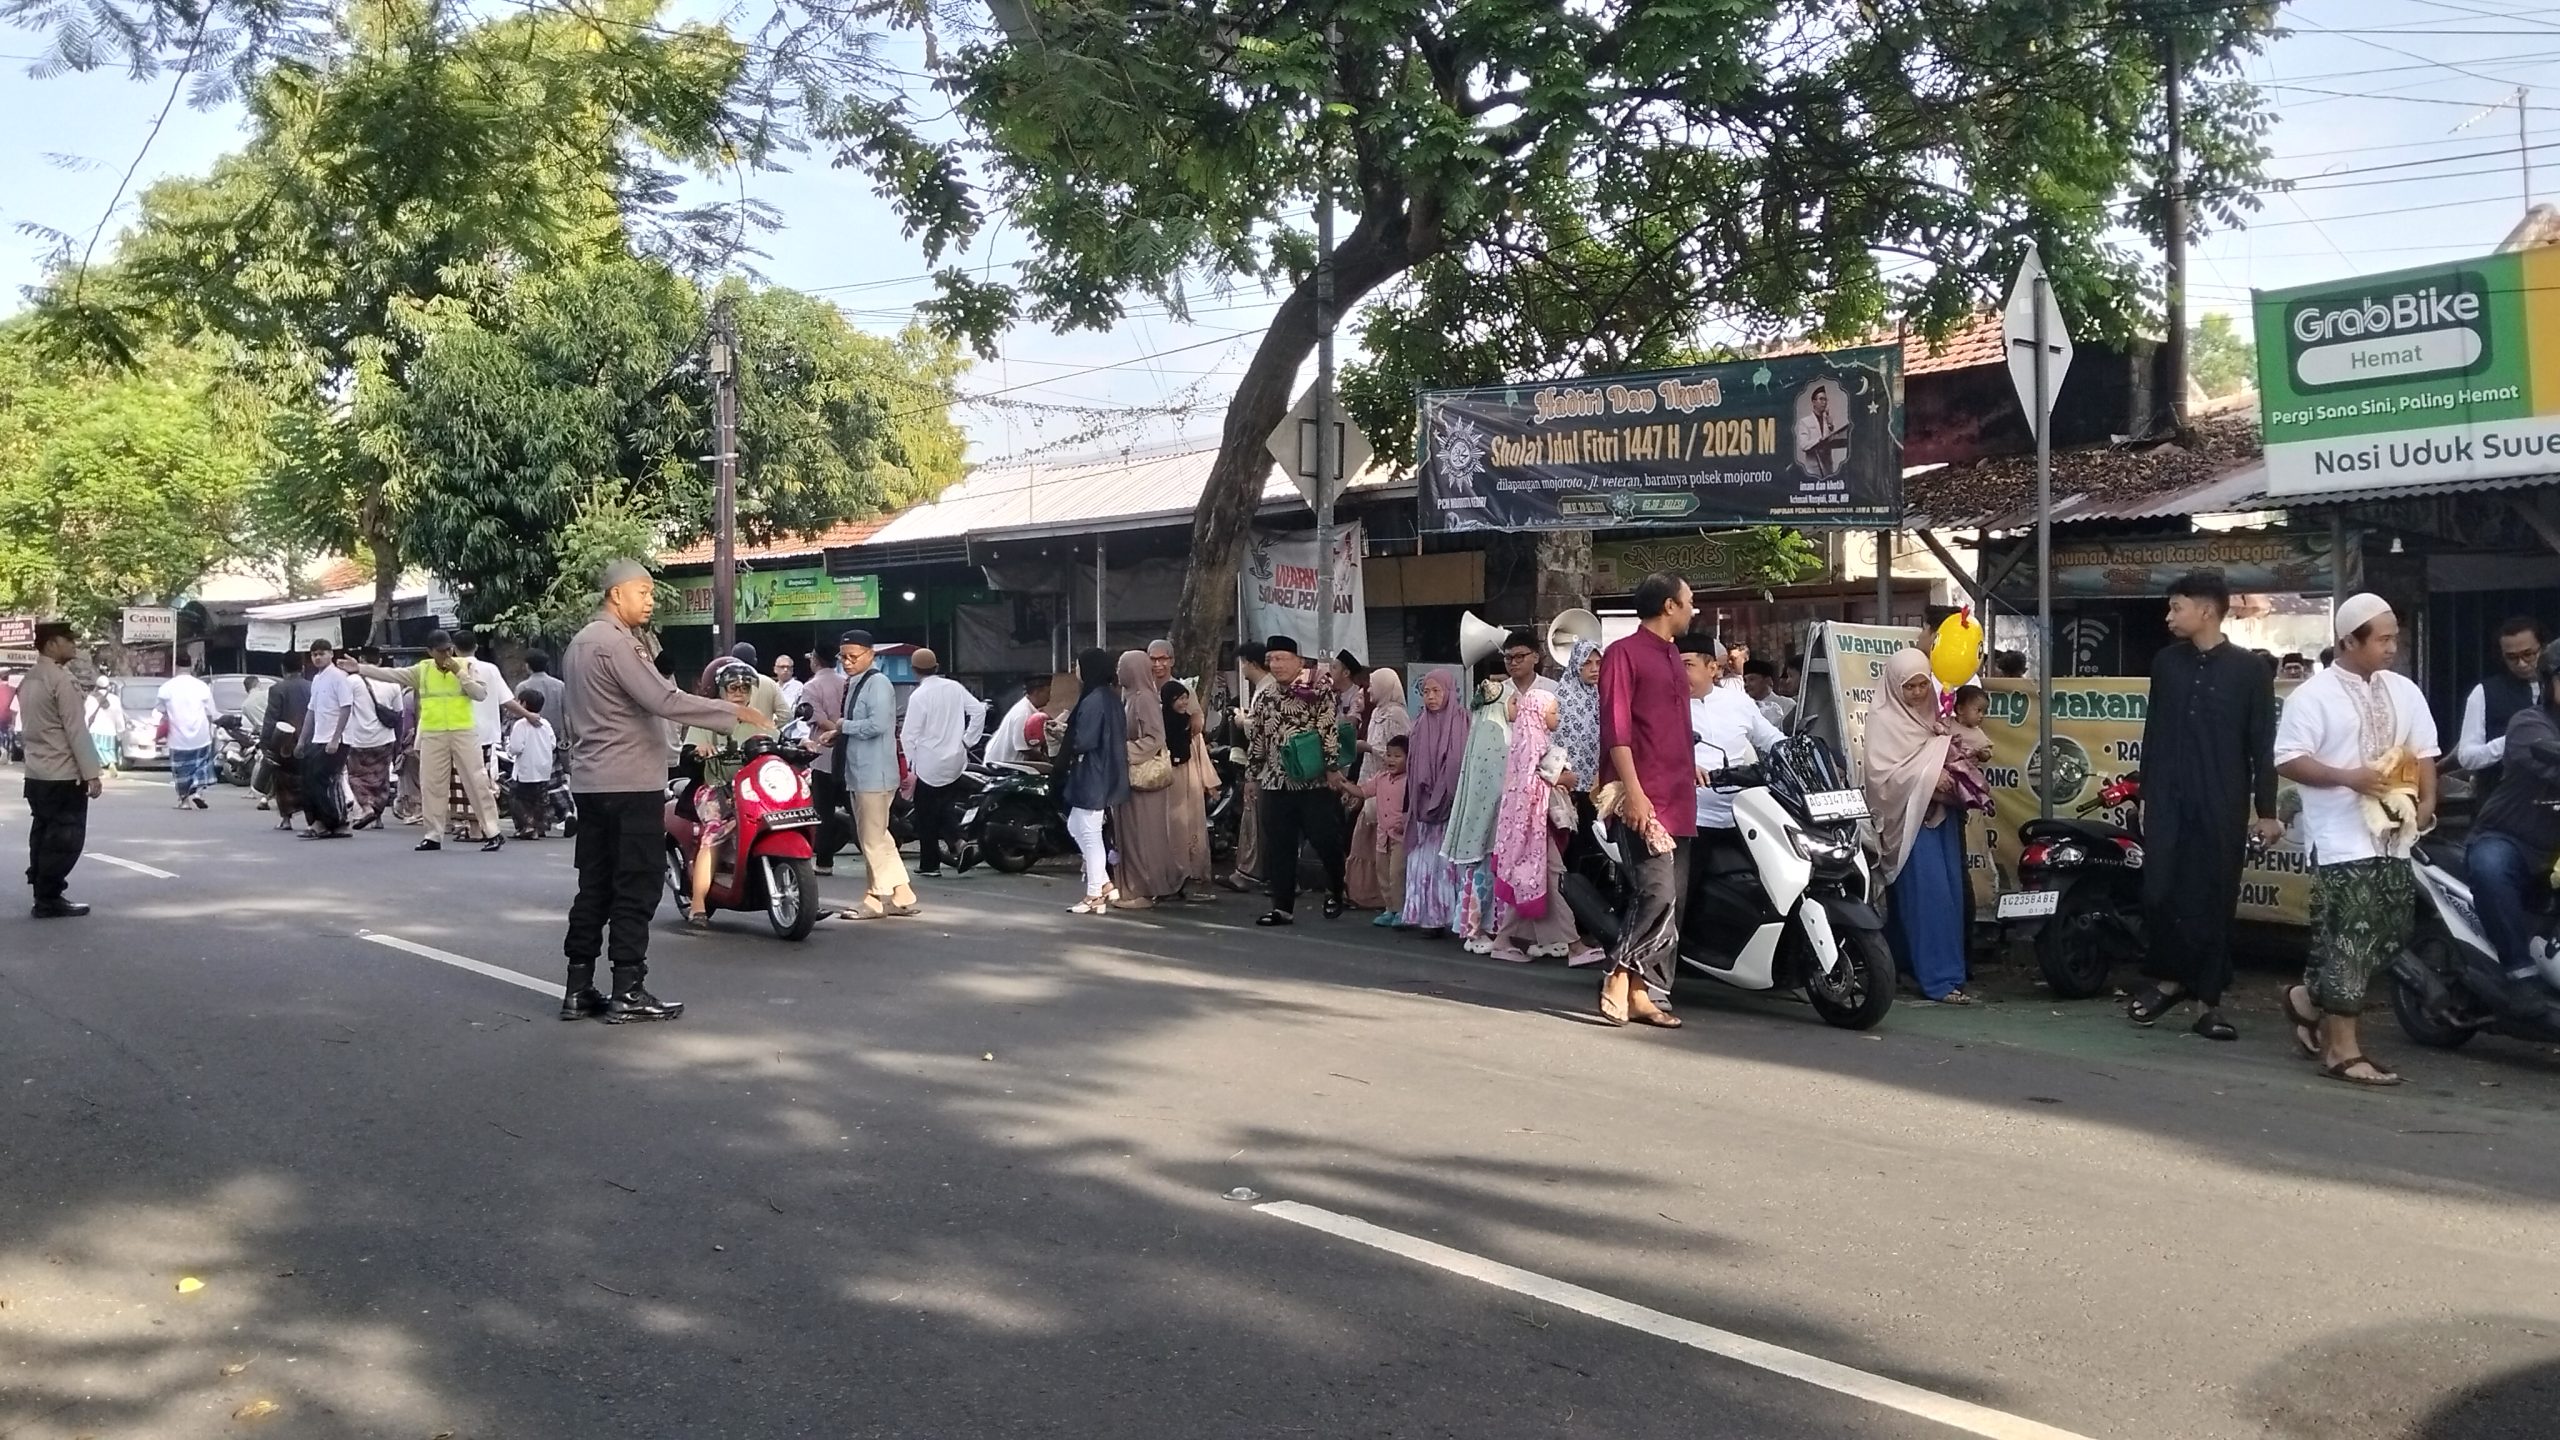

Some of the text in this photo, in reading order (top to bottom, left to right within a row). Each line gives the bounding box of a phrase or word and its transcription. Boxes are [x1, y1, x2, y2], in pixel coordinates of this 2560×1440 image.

[2294, 287, 2480, 342] GrabBike
[2351, 345, 2423, 370] Hemat
[1534, 378, 1721, 424] Hadiri Dan Ikuti
[2272, 384, 2519, 427] Pergi Sana Sini, Paling Hemat
[1491, 418, 1776, 468] Sholat Idul Fitri 1447 H / 2026 M
[2315, 432, 2560, 475] Nasi Uduk Suue
[1496, 477, 1541, 493] dilapangan
[1588, 475, 1599, 491] jl.
[1602, 474, 1642, 489] veteran,
[1644, 472, 1688, 489] baratnya
[1690, 470, 1721, 488] polsek
[1722, 470, 1772, 487] mojoroto
[2051, 549, 2109, 567] inuman
[685, 588, 714, 611] PAR
[129, 613, 171, 624] Canon
[2079, 665, 2099, 673] ree
[2051, 690, 2148, 720] Makan
[1981, 767, 2019, 789] ANG
[2242, 883, 2280, 907] AUK
